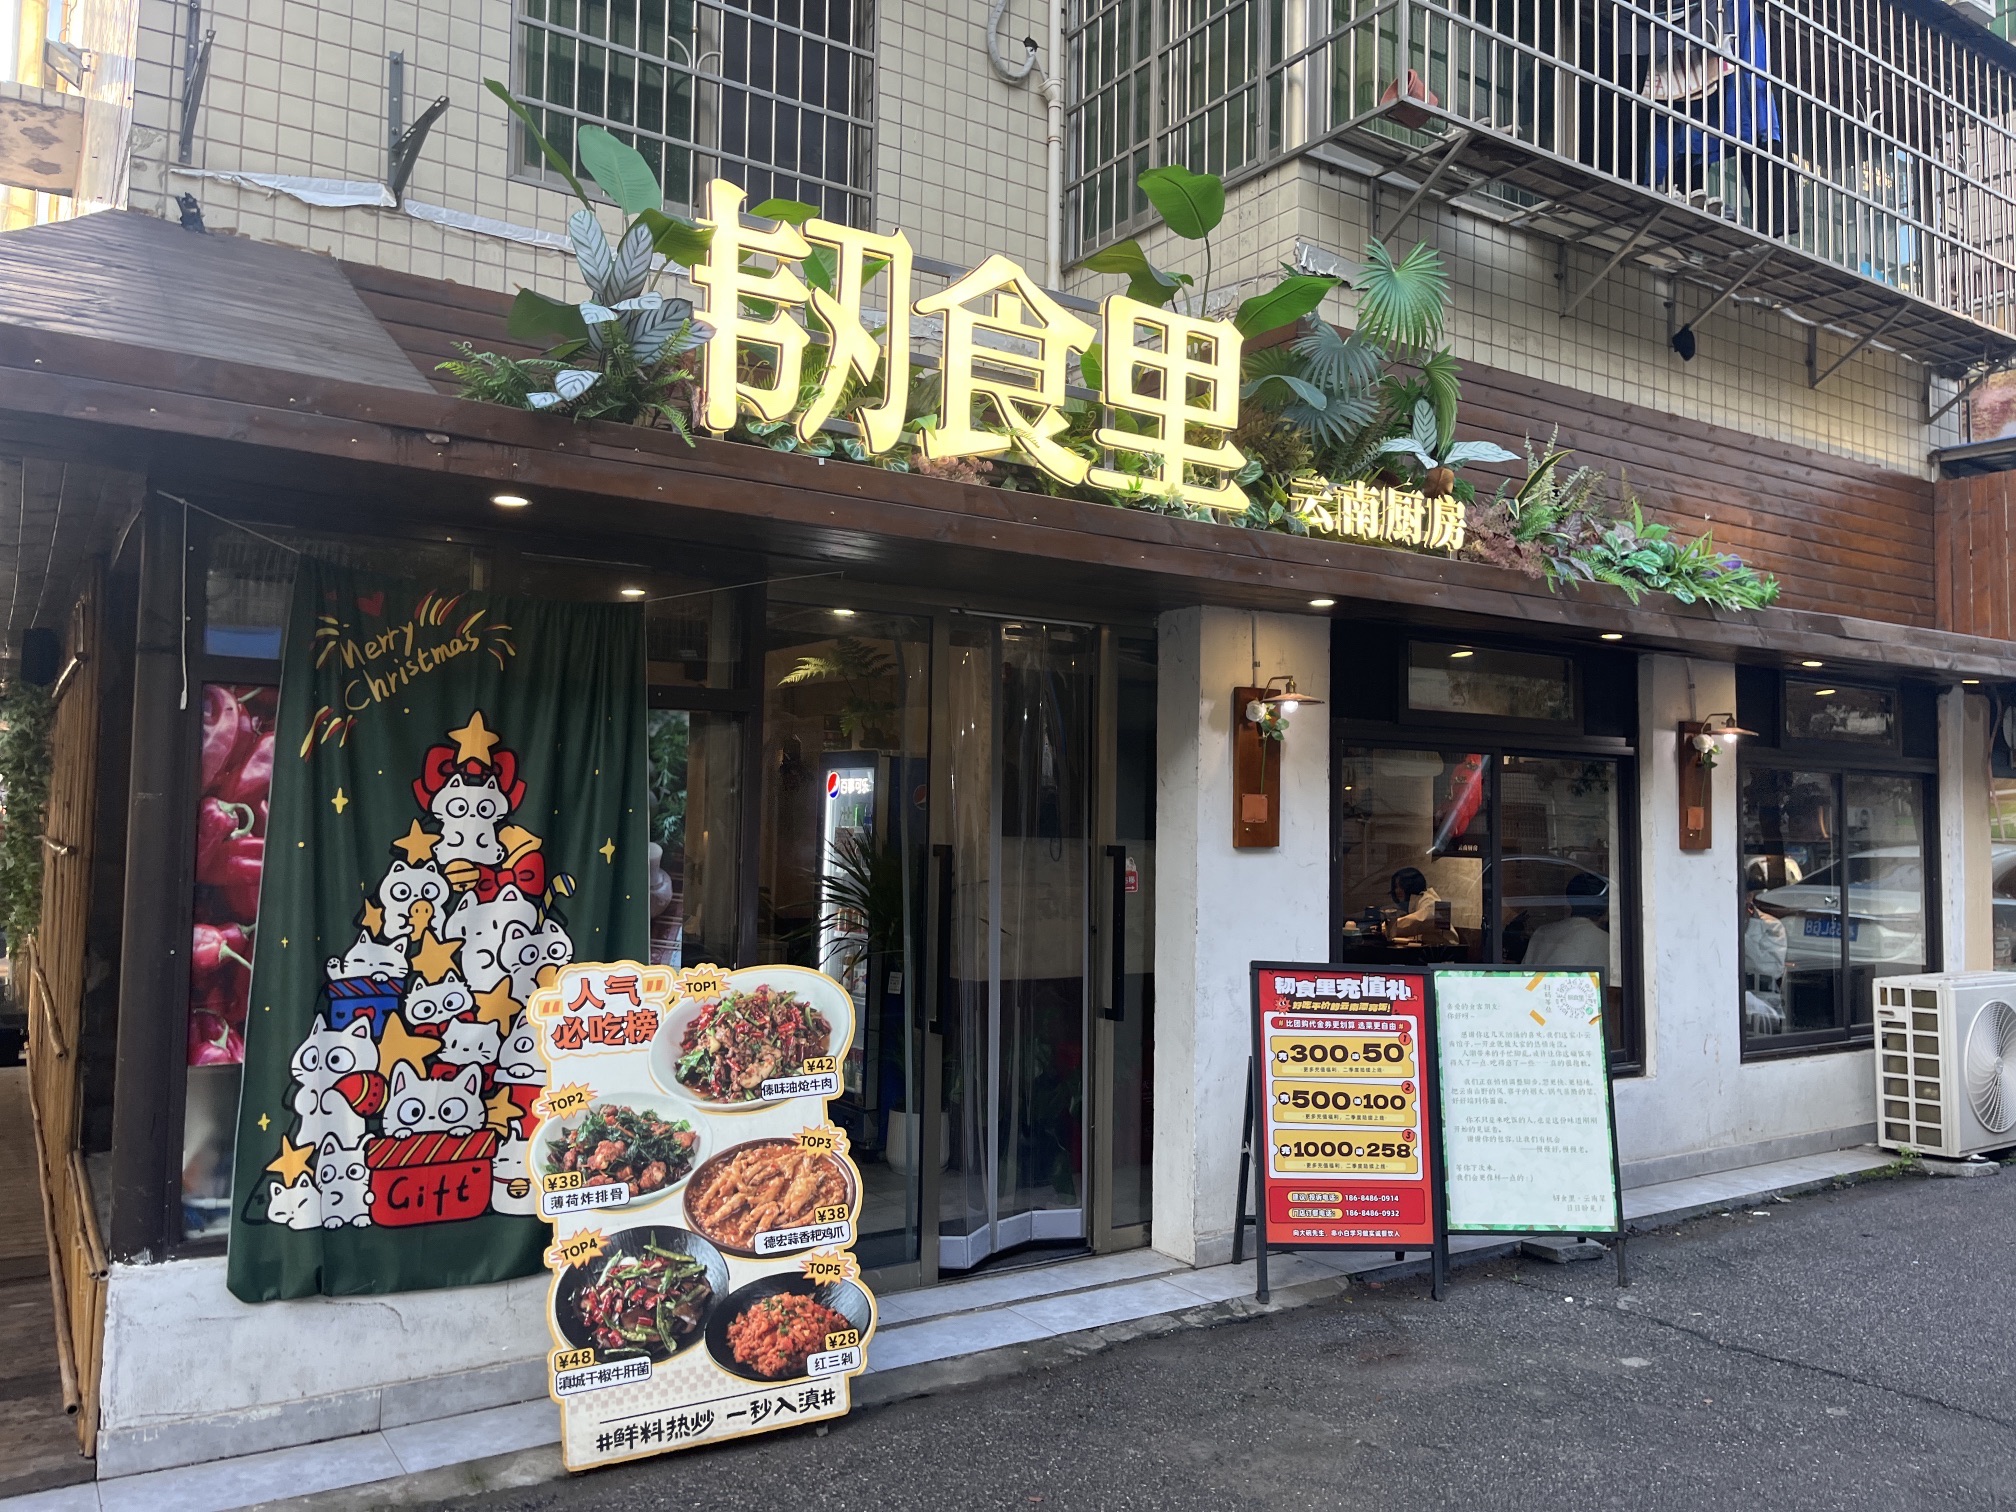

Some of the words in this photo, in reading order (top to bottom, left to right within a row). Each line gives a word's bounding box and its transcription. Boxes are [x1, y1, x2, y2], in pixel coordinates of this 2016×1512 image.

[690, 178, 1250, 511] 韧食里
[1287, 476, 1467, 550] 云南厨房
[345, 630, 479, 710] Christmas
[568, 975, 641, 1011] 人气
[686, 979, 717, 994] TOP1
[1274, 975, 1412, 1001] 韧食里充值礼
[551, 1009, 658, 1050] 必吃榜
[806, 1057, 835, 1072] ¥42
[549, 1092, 585, 1113] TOP2
[800, 1134, 832, 1150] TOP3
[547, 1173, 580, 1190] ¥38
[387, 1174, 470, 1216] Gift
[550, 1188, 623, 1211] 薄荷炸排骨
[1345, 1194, 1399, 1202] 186-8486-0914
[817, 1207, 846, 1223] ¥38
[561, 1238, 598, 1258] TOP4
[808, 1261, 841, 1276] TOP5
[828, 1332, 857, 1348] ¥28
[558, 1350, 592, 1369] ¥48
[814, 1352, 853, 1372] 红三剁
[558, 1361, 650, 1391] 滇城干椒牛肝菌
[596, 1409, 715, 1453] #鲜料热炒
[727, 1388, 836, 1425] 一秒入滇#
